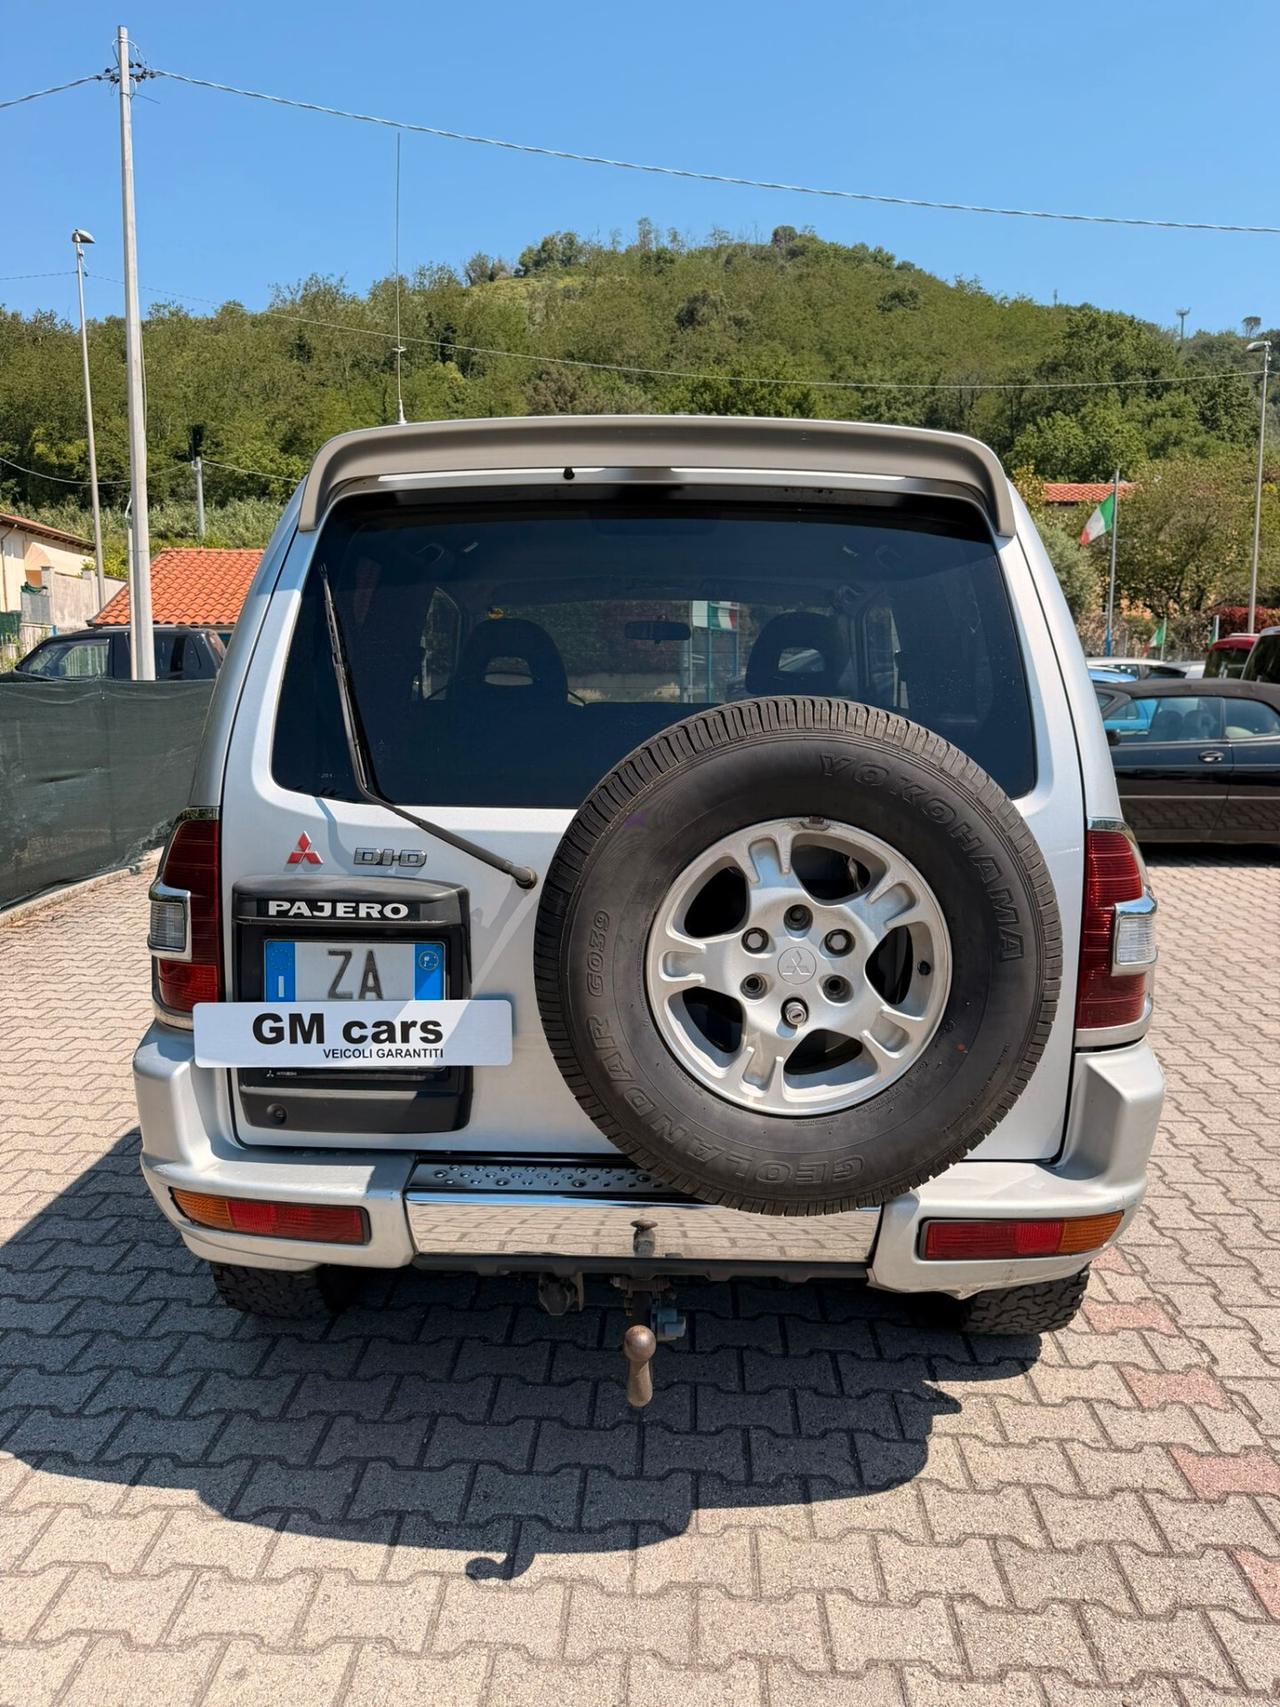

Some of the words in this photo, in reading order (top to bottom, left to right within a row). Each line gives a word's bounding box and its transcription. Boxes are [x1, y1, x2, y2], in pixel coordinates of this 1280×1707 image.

[819, 752, 1024, 962] YOKOHAMA
[268, 901, 408, 919] PAJERO
[328, 950, 383, 1000] ZA
[252, 1012, 325, 1045] GM
[341, 1018, 444, 1045] cars
[323, 1048, 373, 1059] VEICOLI
[376, 1048, 444, 1060] GARANTITI
